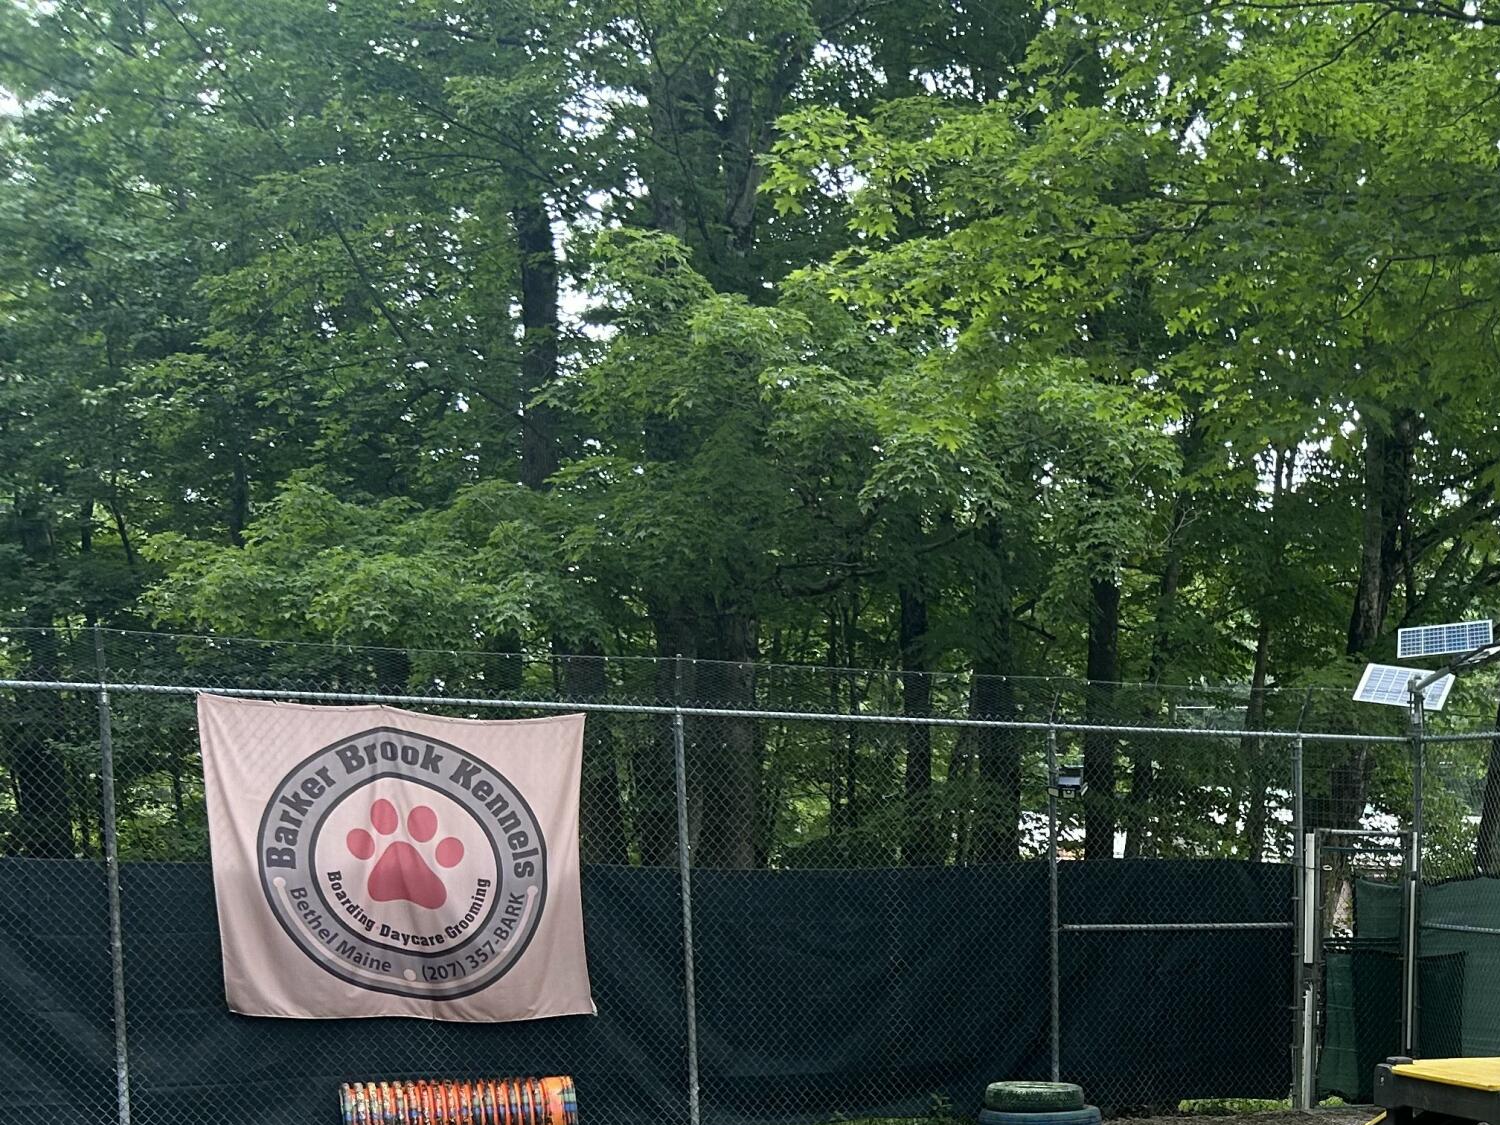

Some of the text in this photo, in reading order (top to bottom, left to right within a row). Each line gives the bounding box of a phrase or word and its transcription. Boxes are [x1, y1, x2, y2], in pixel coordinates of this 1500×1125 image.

[266, 741, 538, 880] Barker Brook Kennels
[290, 886, 392, 973] Bethel Maine
[327, 870, 491, 947] Boarding Daycare Grooming
[421, 891, 526, 982] (207) 357-BARK
